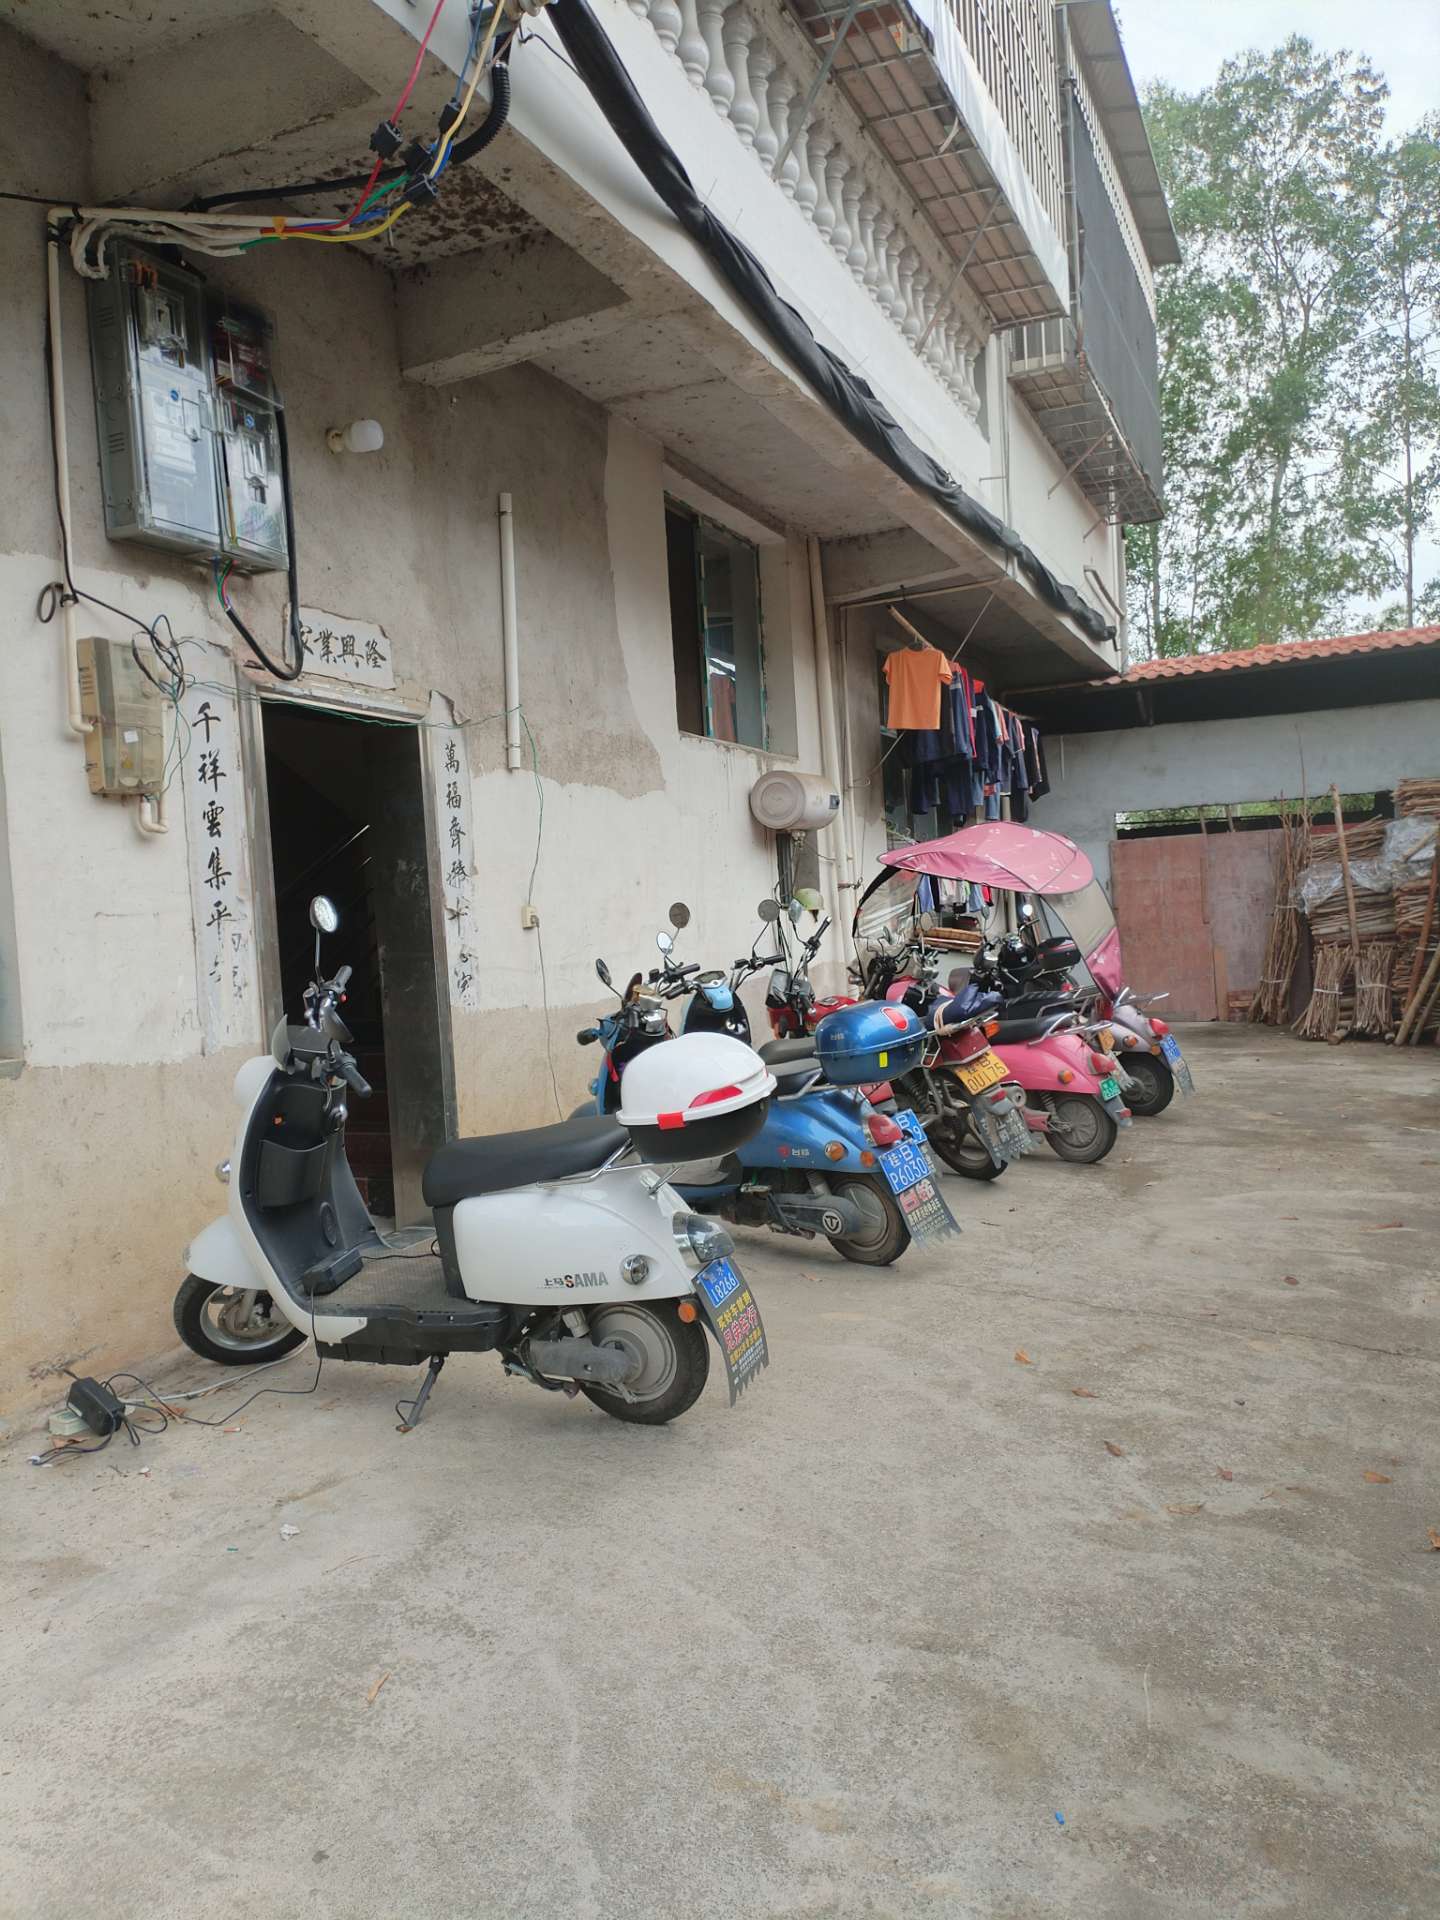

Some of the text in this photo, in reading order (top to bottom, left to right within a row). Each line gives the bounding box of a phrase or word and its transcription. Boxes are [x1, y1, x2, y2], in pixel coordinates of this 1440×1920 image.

[889, 1158, 928, 1192] P6030
[564, 1272, 609, 1288] SAMA
[710, 1272, 736, 1303] 18266
